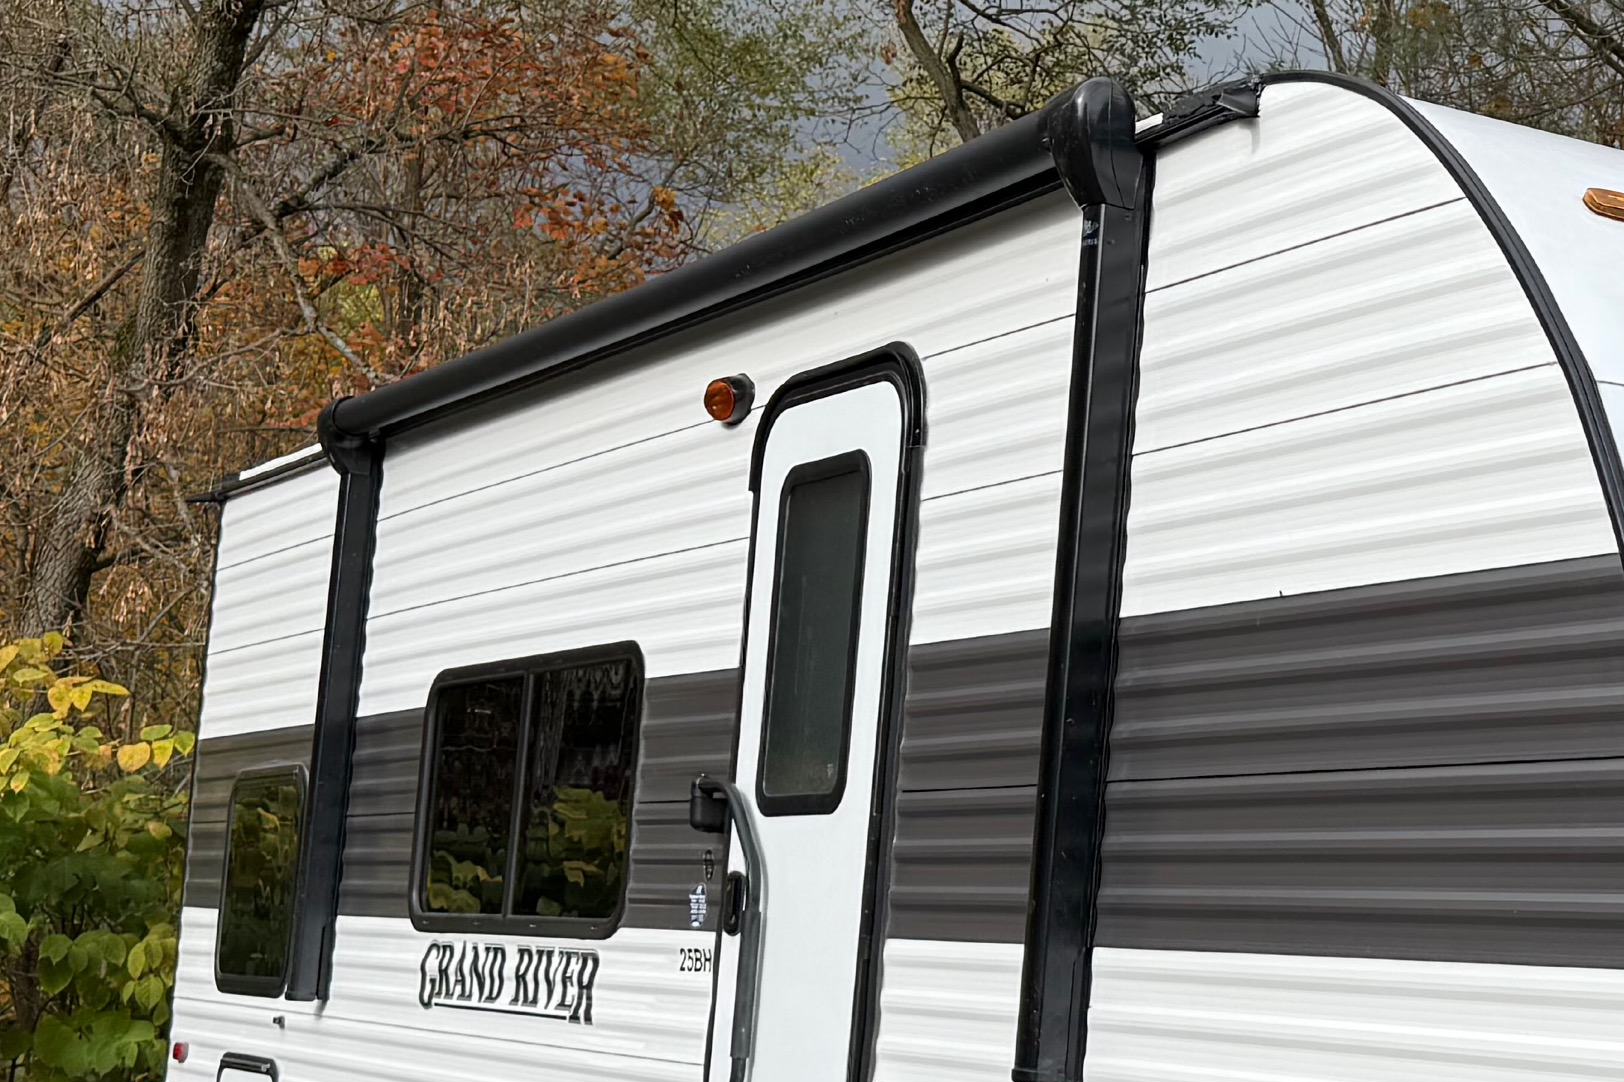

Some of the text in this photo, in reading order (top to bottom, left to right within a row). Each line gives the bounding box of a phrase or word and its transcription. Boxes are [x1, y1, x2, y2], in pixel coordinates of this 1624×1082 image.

[419, 940, 599, 1025] GRAND RIVER
[679, 948, 712, 972] 25BH
